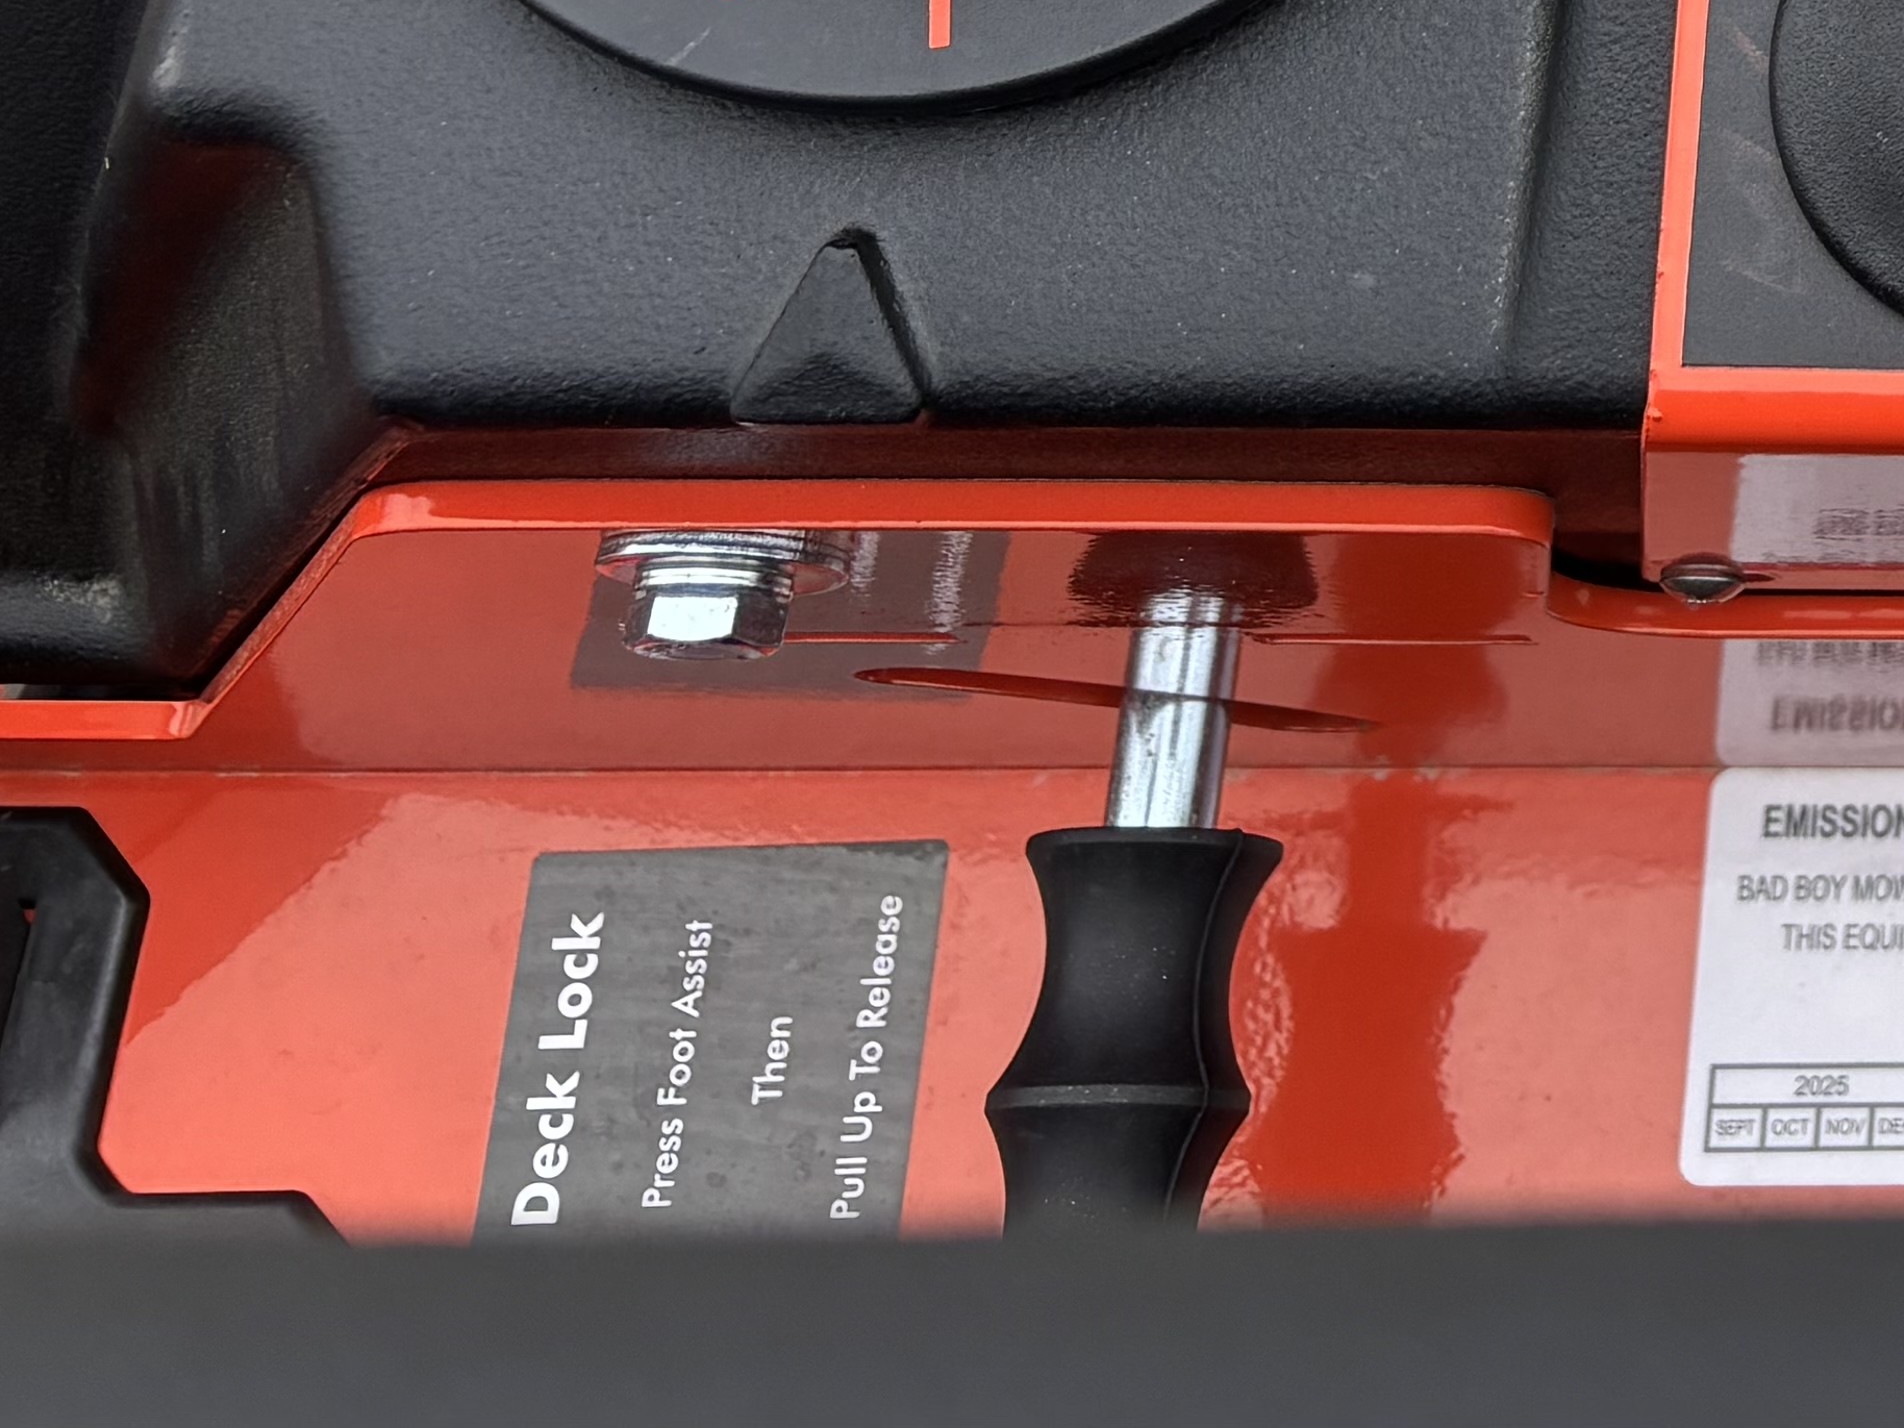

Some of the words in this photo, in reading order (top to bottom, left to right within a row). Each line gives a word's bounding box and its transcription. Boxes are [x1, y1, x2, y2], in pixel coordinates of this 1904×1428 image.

[1737, 875, 1787, 902] BAD
[1794, 875, 1848, 902] BOY
[672, 921, 713, 1017] Assist
[856, 895, 903, 1027] Release
[1782, 923, 1837, 950] THIS
[537, 913, 605, 1050] Lock
[657, 1028, 697, 1105] Foot
[751, 1016, 794, 1105] Then
[850, 1041, 883, 1080] To
[1793, 1075, 1850, 1097] 2025
[511, 1071, 580, 1225] Deck
[840, 1091, 883, 1143] Up
[1714, 1119, 1756, 1137] SEPT
[1771, 1118, 1809, 1136] OCT
[1825, 1117, 1864, 1136] NOV
[642, 1118, 683, 1208] Press
[830, 1158, 868, 1219] Pull
